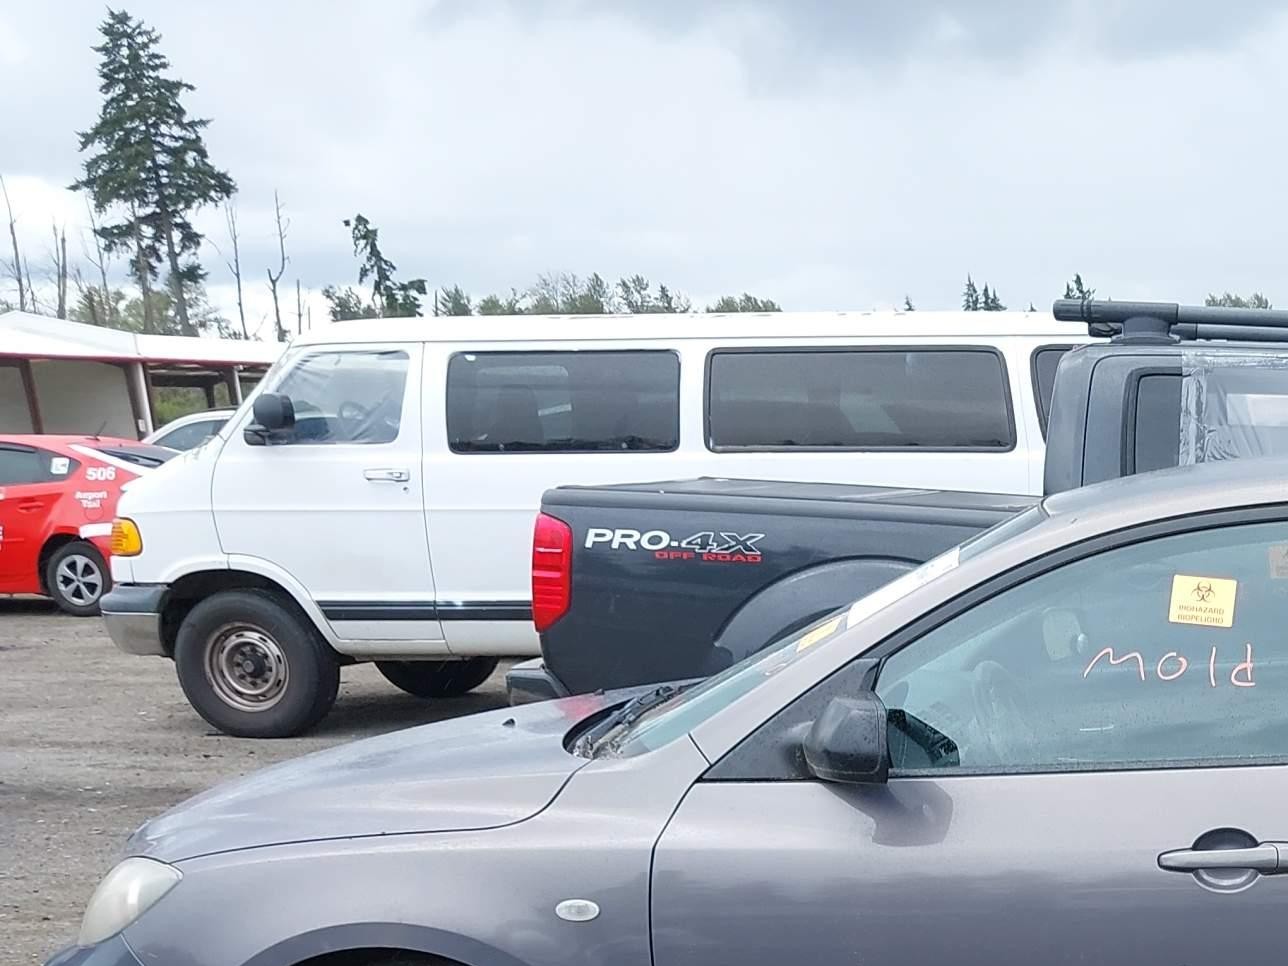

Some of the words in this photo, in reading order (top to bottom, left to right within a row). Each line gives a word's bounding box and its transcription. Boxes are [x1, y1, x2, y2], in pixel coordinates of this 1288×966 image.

[85, 466, 116, 481] 506
[655, 551, 694, 560] OFF
[703, 553, 762, 562] ROAD
[1179, 605, 1224, 615] BIOHAZARD
